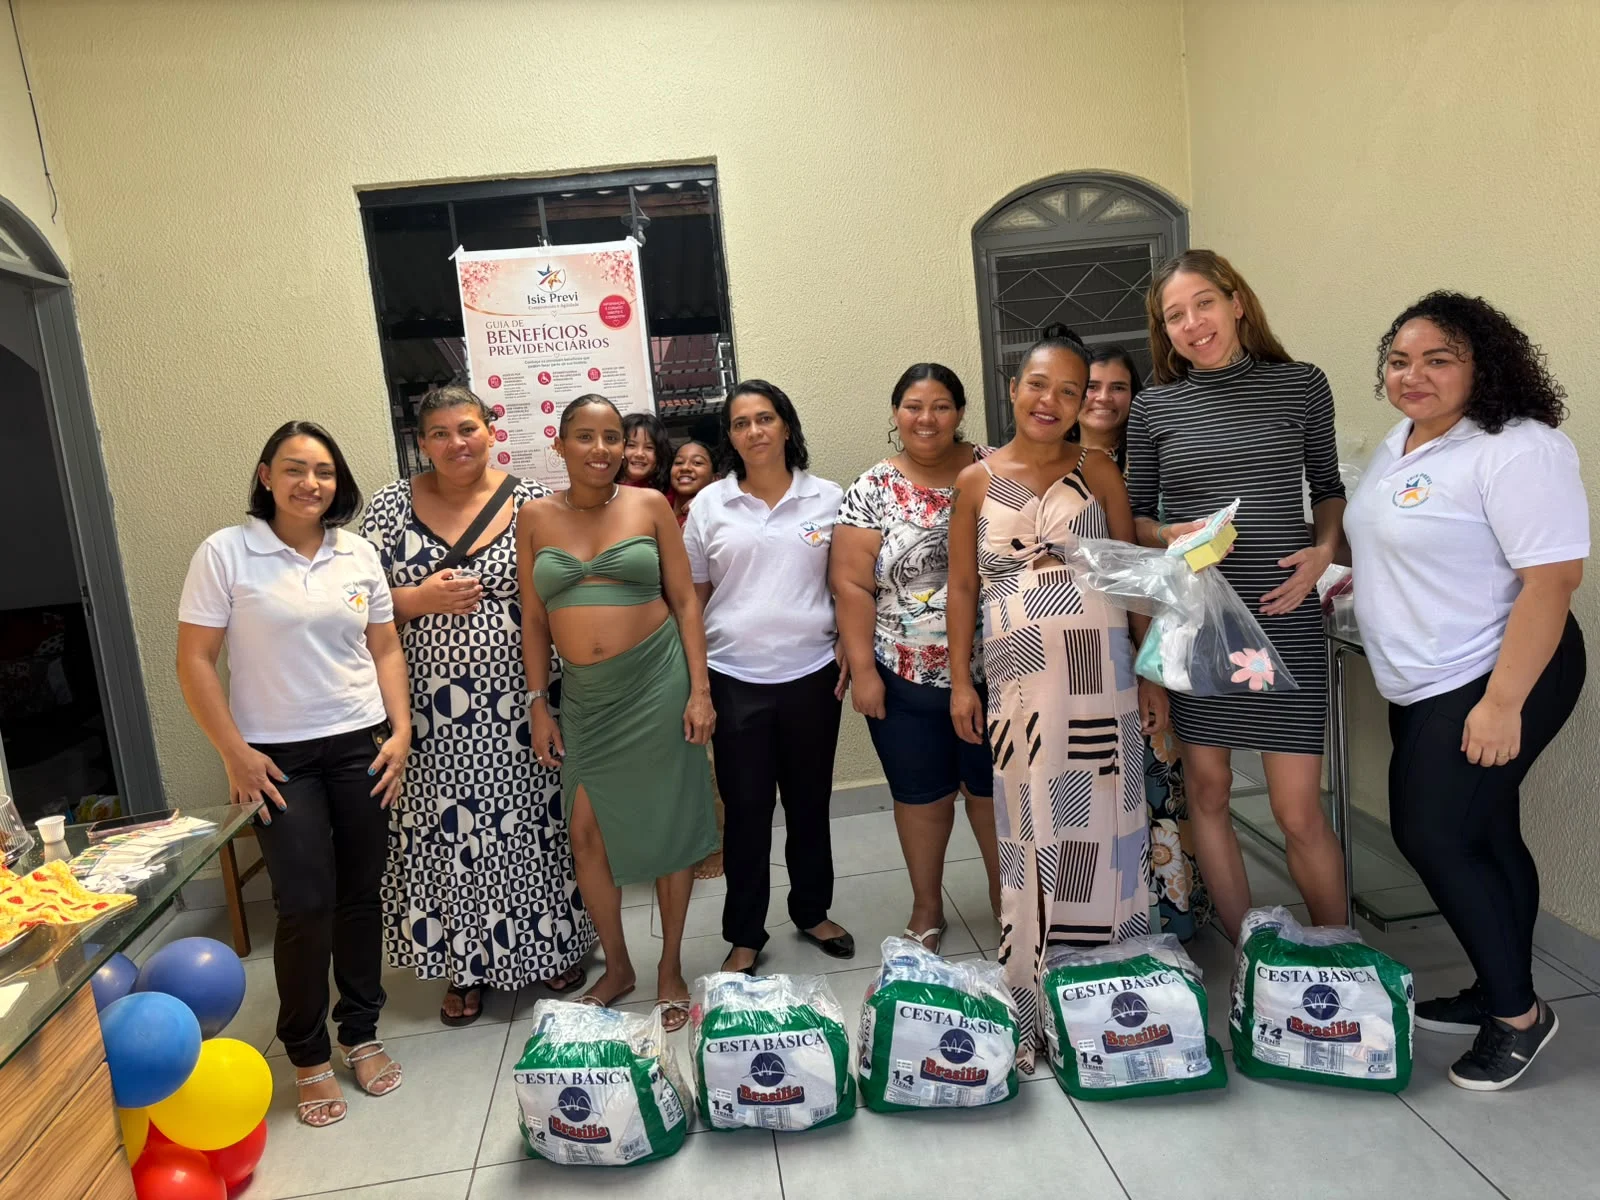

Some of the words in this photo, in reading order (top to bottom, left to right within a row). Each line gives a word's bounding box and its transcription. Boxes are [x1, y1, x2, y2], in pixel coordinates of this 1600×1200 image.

[527, 293, 546, 305] Isis
[549, 291, 578, 304] Previ
[485, 321, 510, 330] GUIA
[512, 319, 524, 328] DE
[486, 323, 588, 345] BENEFÍCIOS
[488, 337, 610, 357] PREVIDENCIÁRIOS
[1257, 966, 1315, 984] CESTA
[1318, 967, 1377, 984] BÁSICA
[1062, 982, 1119, 1002] CESTA
[1121, 972, 1181, 992] BÁSICA
[899, 1005, 954, 1026] CESTA
[1104, 1023, 1170, 1047] Brasília
[1257, 1023, 1283, 1040] 14
[1288, 1015, 1359, 1038] Brasília
[706, 1038, 761, 1054] CESTA
[763, 1032, 825, 1052] BÁSICA
[1256, 1034, 1281, 1047] ITENS
[1080, 1051, 1104, 1066] 14
[513, 1072, 567, 1085] CESTA
[571, 1069, 631, 1085] BÁSICA
[892, 1070, 915, 1086] 14
[924, 1056, 987, 1081] Brasília
[739, 1084, 803, 1103] Brasília
[711, 1100, 734, 1114] 14
[550, 1115, 609, 1140] Brasília
